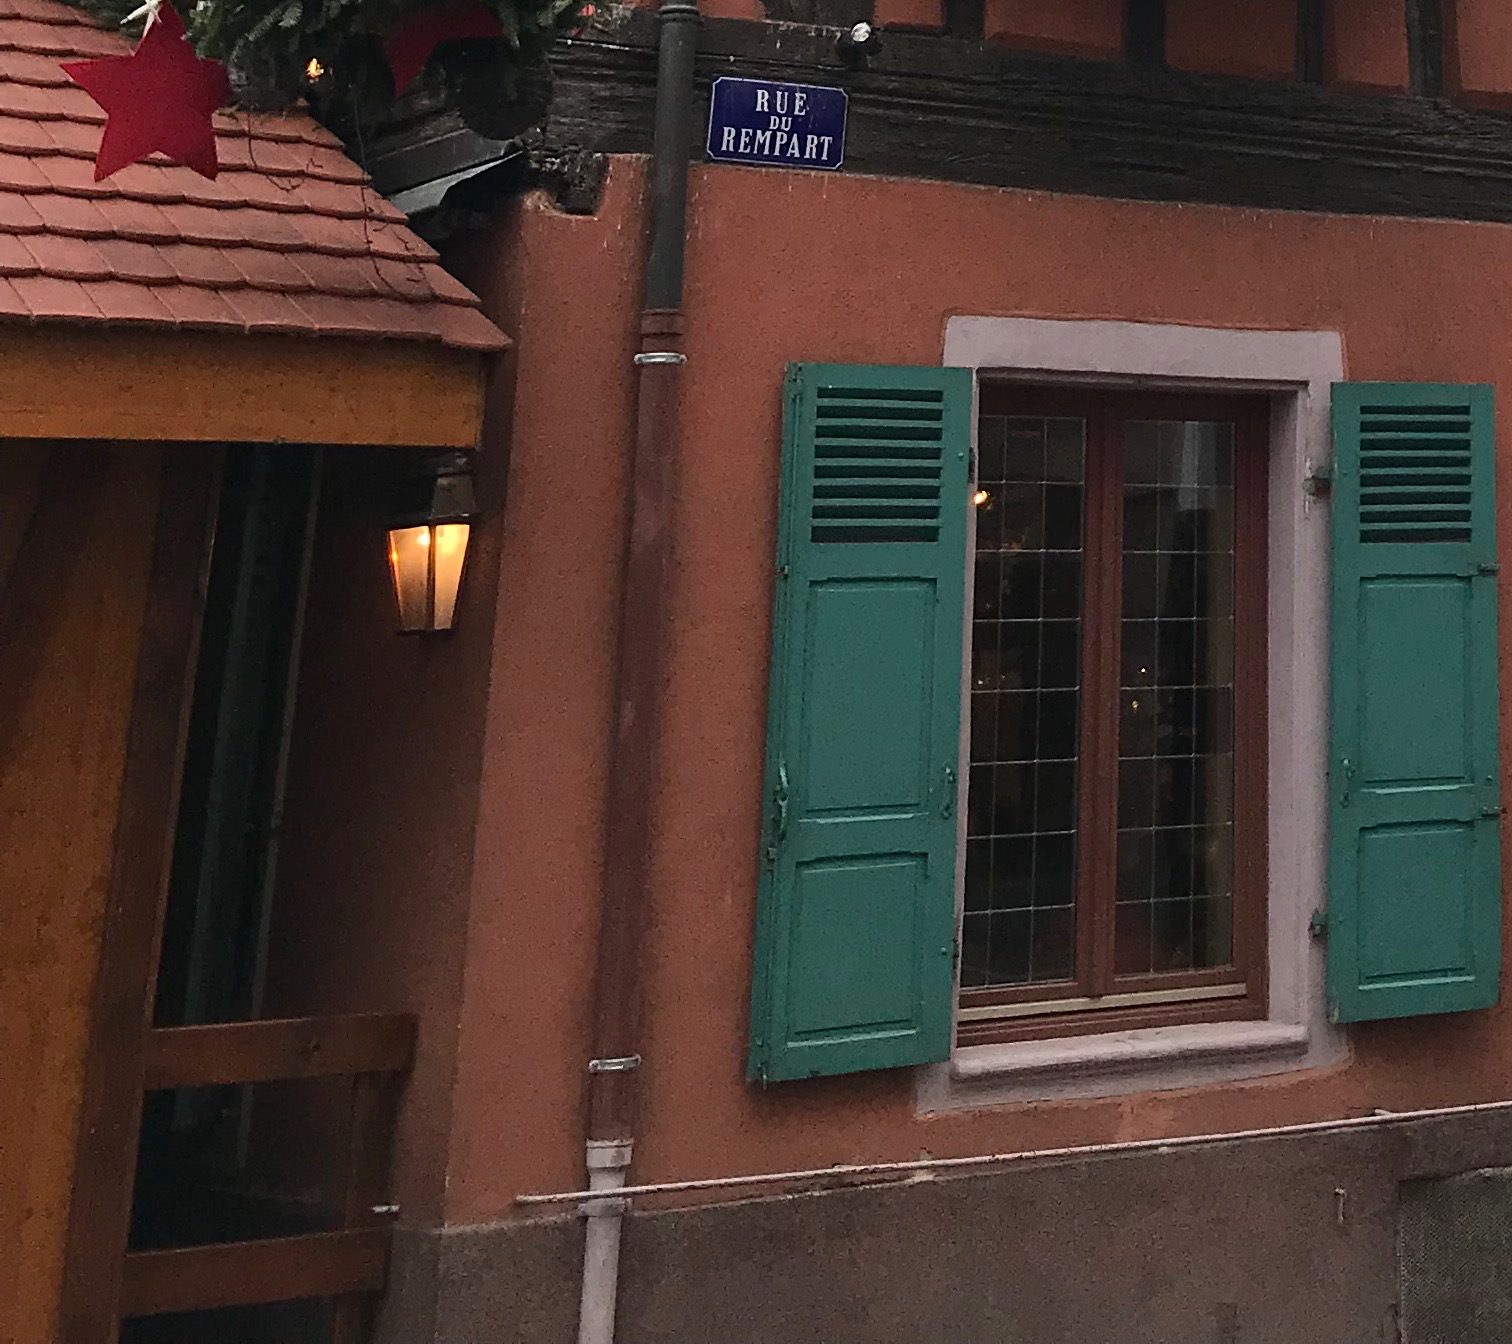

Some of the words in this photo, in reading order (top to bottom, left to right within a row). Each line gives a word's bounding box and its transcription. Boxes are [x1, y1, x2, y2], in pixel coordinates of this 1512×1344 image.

[755, 89, 807, 116] RUE
[769, 115, 793, 131] DU
[721, 126, 833, 161] REMPART
